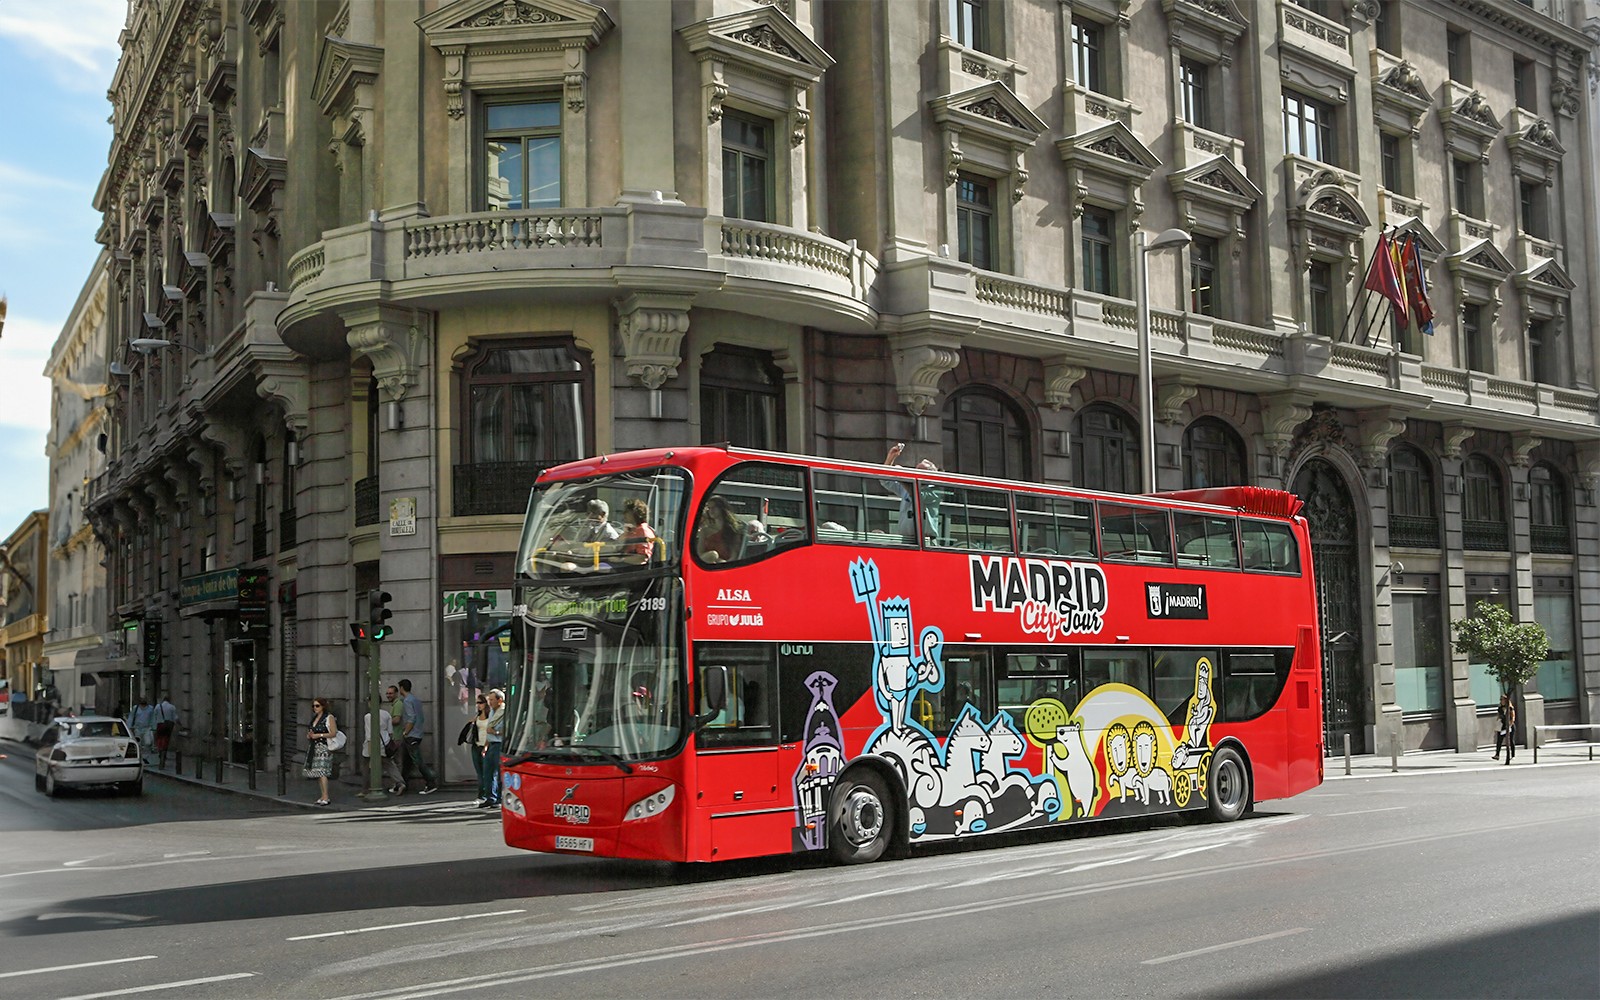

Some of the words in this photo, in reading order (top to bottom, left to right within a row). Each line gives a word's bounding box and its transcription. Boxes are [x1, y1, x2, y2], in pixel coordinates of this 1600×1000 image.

[968, 554, 1107, 615] MADRID
[716, 588, 752, 602] ALSA
[1165, 587, 1203, 616] ¡MADRID!
[640, 597, 666, 611] 3189
[707, 614, 729, 626] GRUPO
[1021, 598, 1061, 643] City
[1057, 599, 1105, 637] Tour
[554, 804, 590, 818] MADRID
